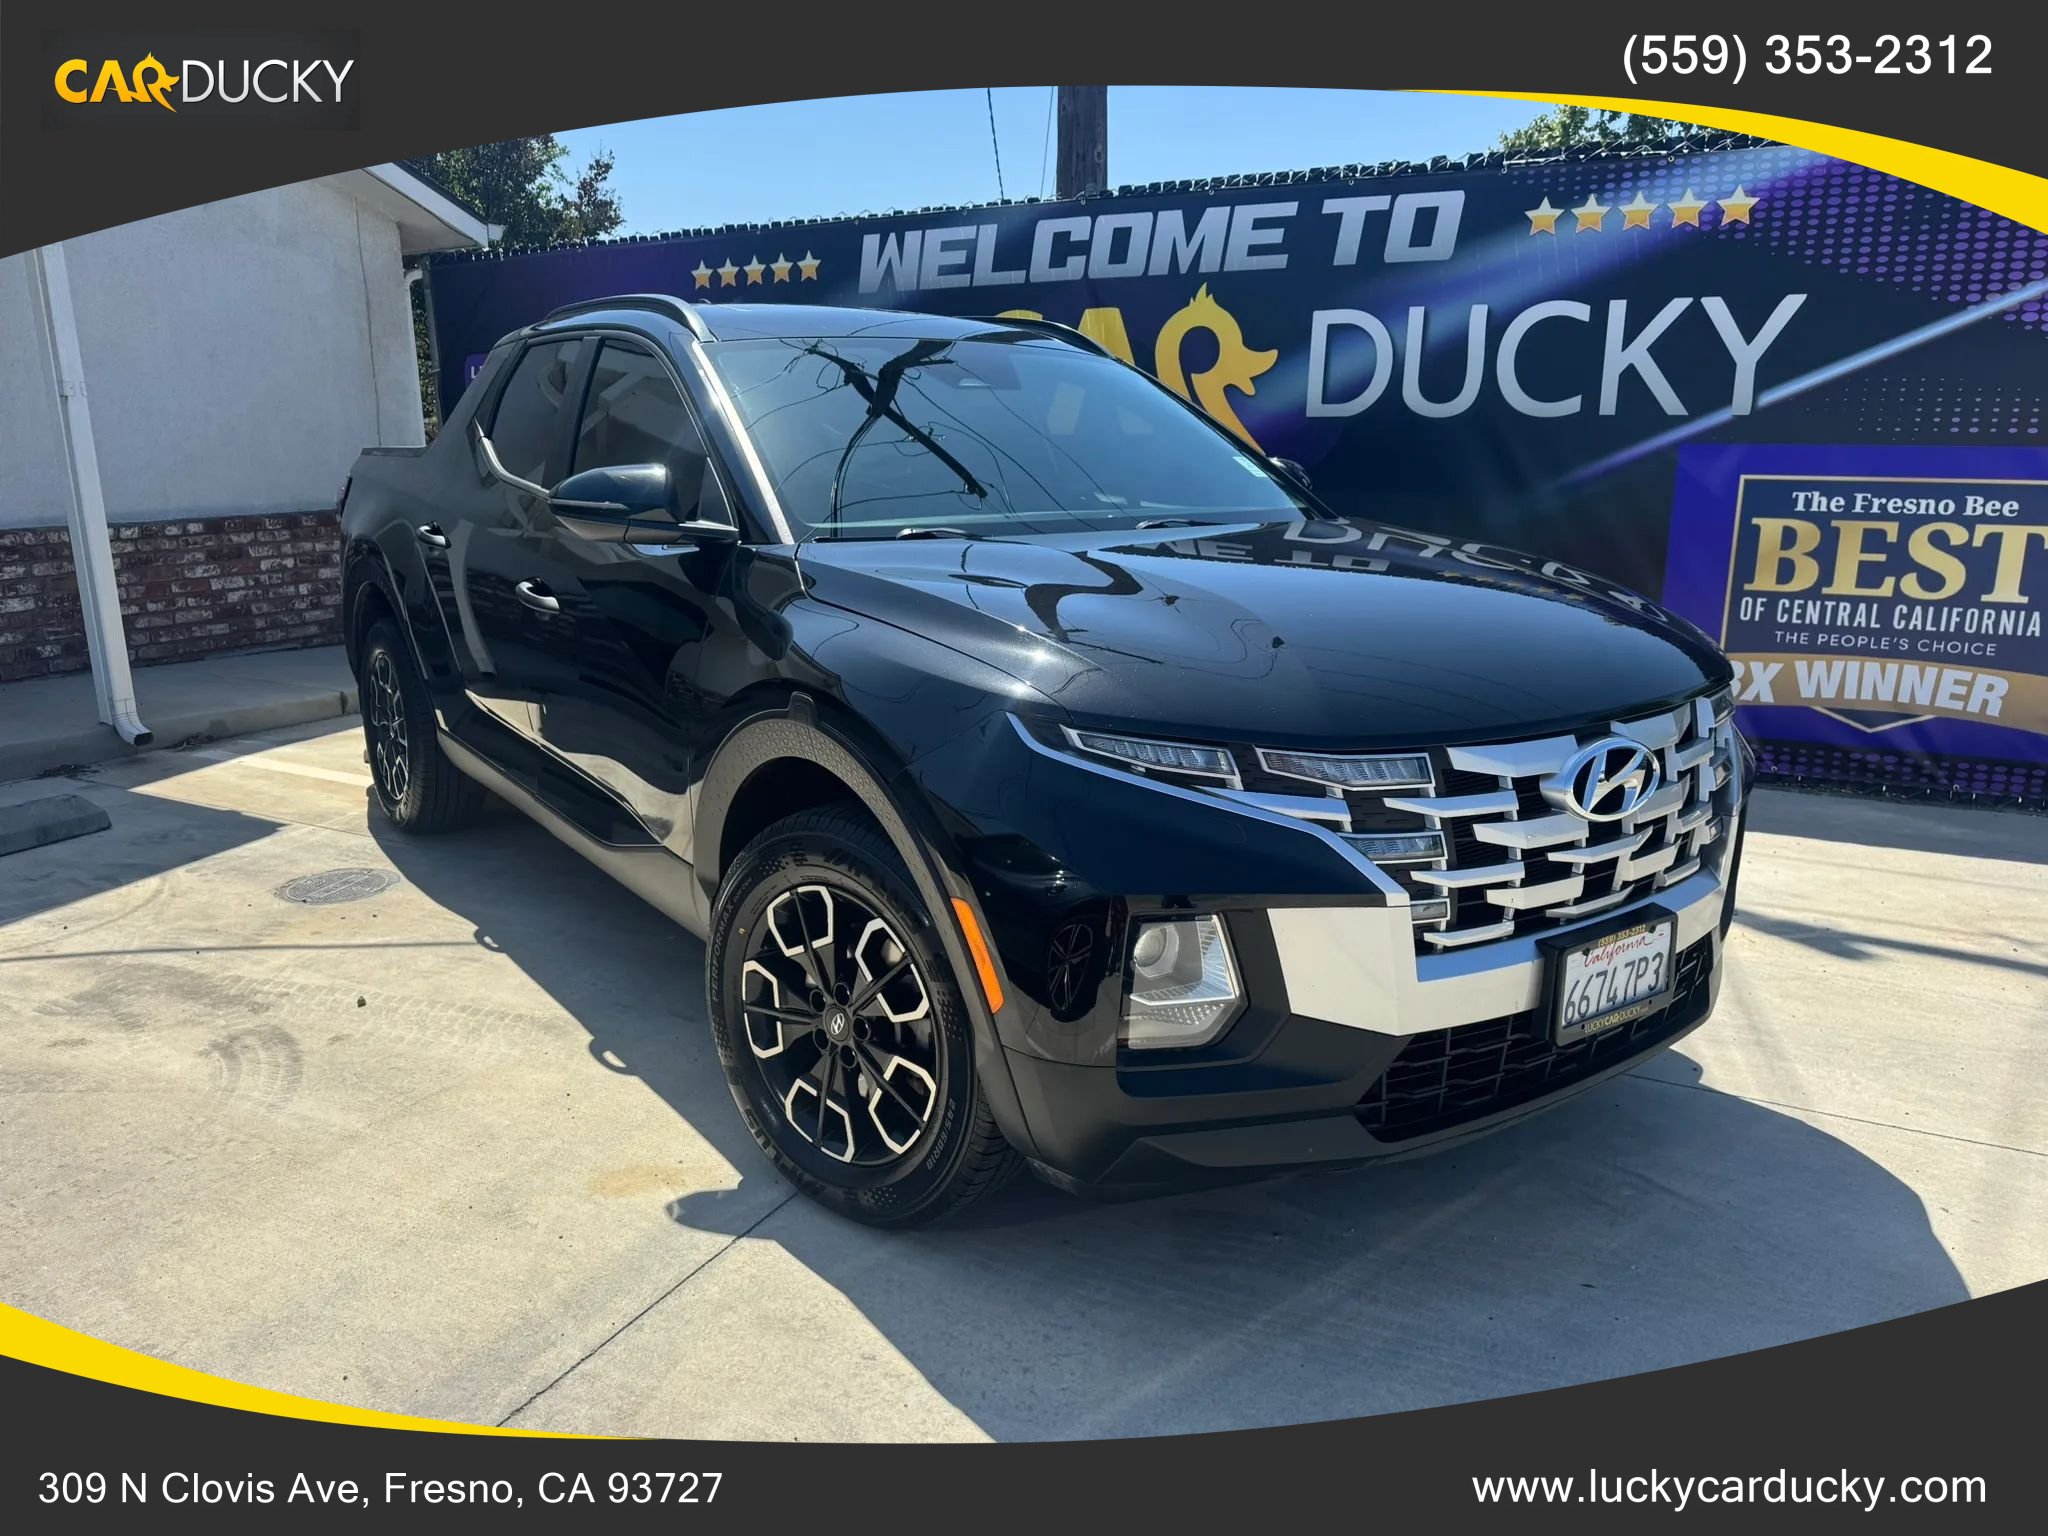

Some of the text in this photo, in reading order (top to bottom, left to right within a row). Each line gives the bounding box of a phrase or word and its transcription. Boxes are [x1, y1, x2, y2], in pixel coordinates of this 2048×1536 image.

[858, 189, 1466, 293] WELCOME TO
[1305, 293, 1808, 419] DUCKY
[1792, 490, 2019, 517] The Fresno Bee
[1743, 517, 2048, 604] BEST
[1739, 597, 2042, 638] OF CENTRAL CALIFORNIA
[1774, 630, 1997, 656] THE PEOPLE'S CHOICE
[1794, 659, 2009, 717] WINNER
[1584, 934, 1654, 968] California
[1564, 951, 1664, 1025] 66747P3
